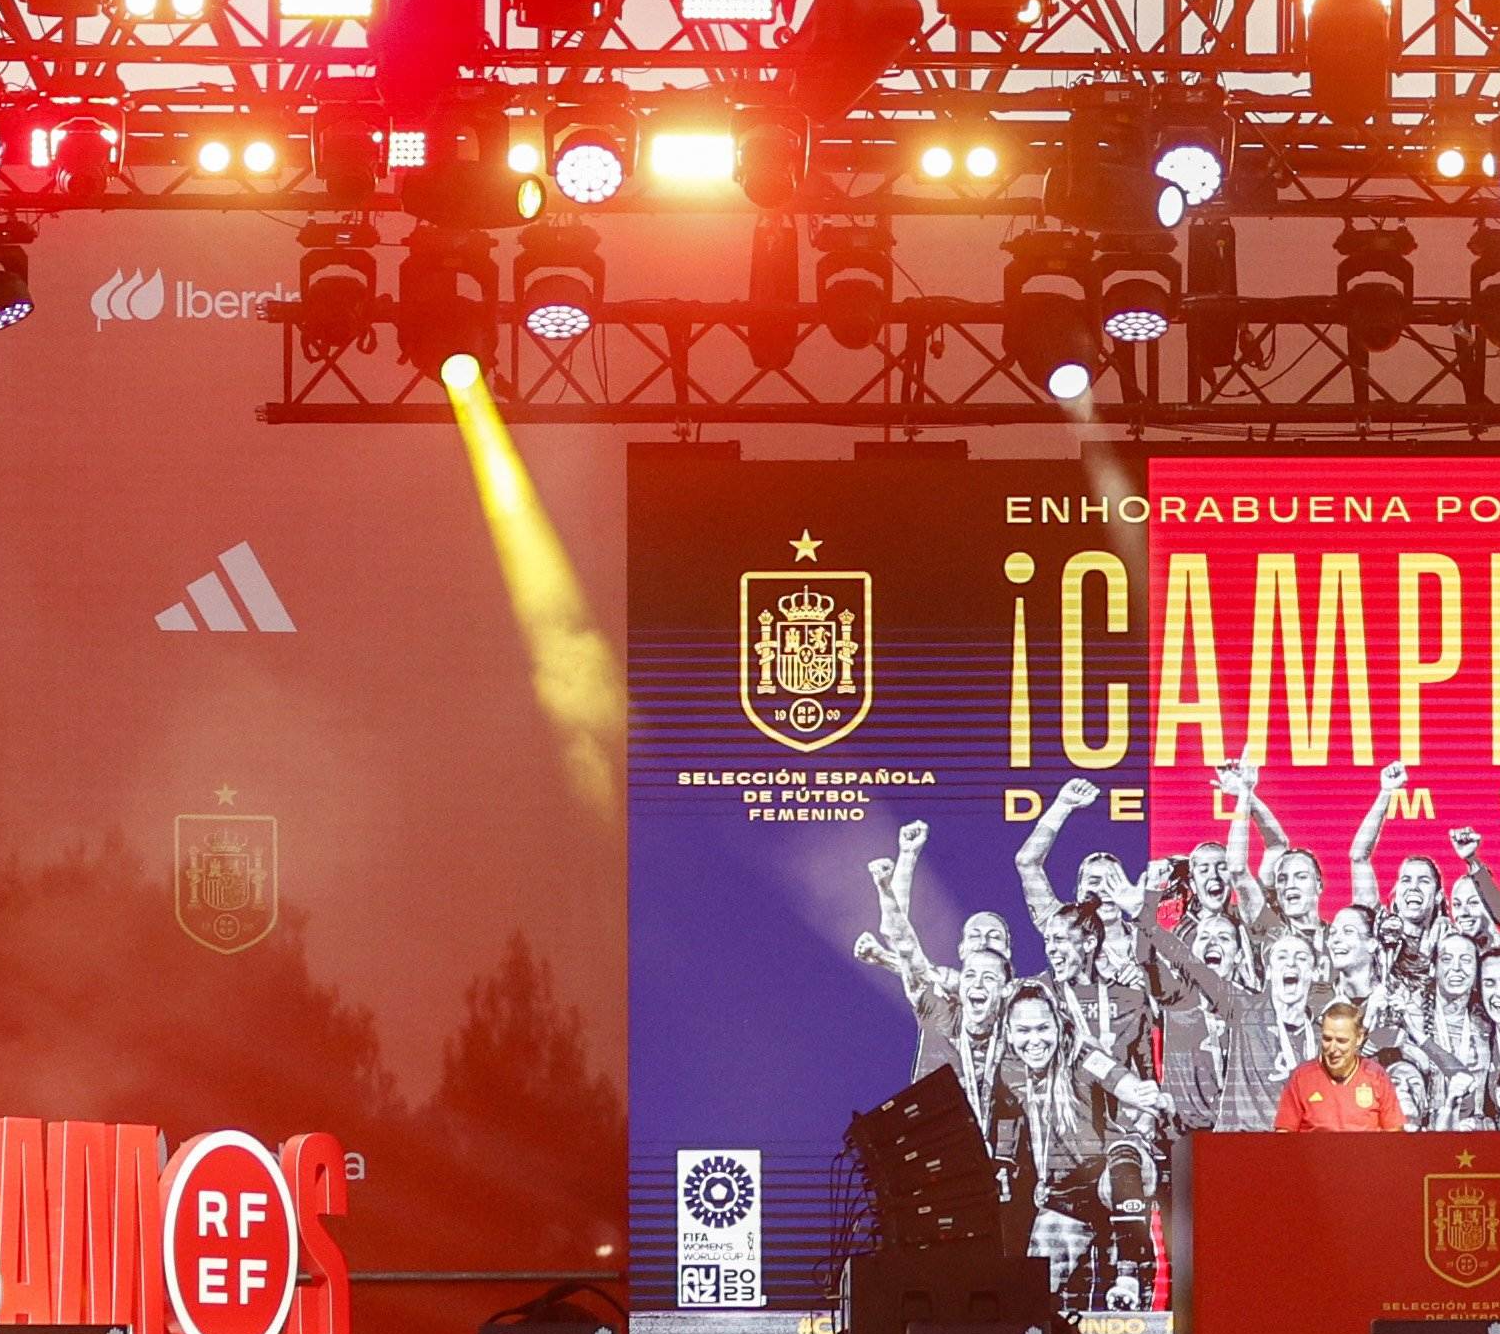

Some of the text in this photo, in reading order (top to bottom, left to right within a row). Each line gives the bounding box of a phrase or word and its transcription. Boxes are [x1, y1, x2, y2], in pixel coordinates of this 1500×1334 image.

[1005, 495, 1412, 525] ENHORABUENA
[678, 769, 936, 785] SELECCIÓN ESPAÑOLA
[743, 787, 870, 803] DE FÚTBOL
[749, 808, 865, 821] FEMENINO
[683, 1232, 708, 1242] FIFA
[683, 1242, 733, 1251] WOMEN'S
[683, 1253, 744, 1261] WORLD CUP
[1382, 1301, 1467, 1312] SELECCIÓN
